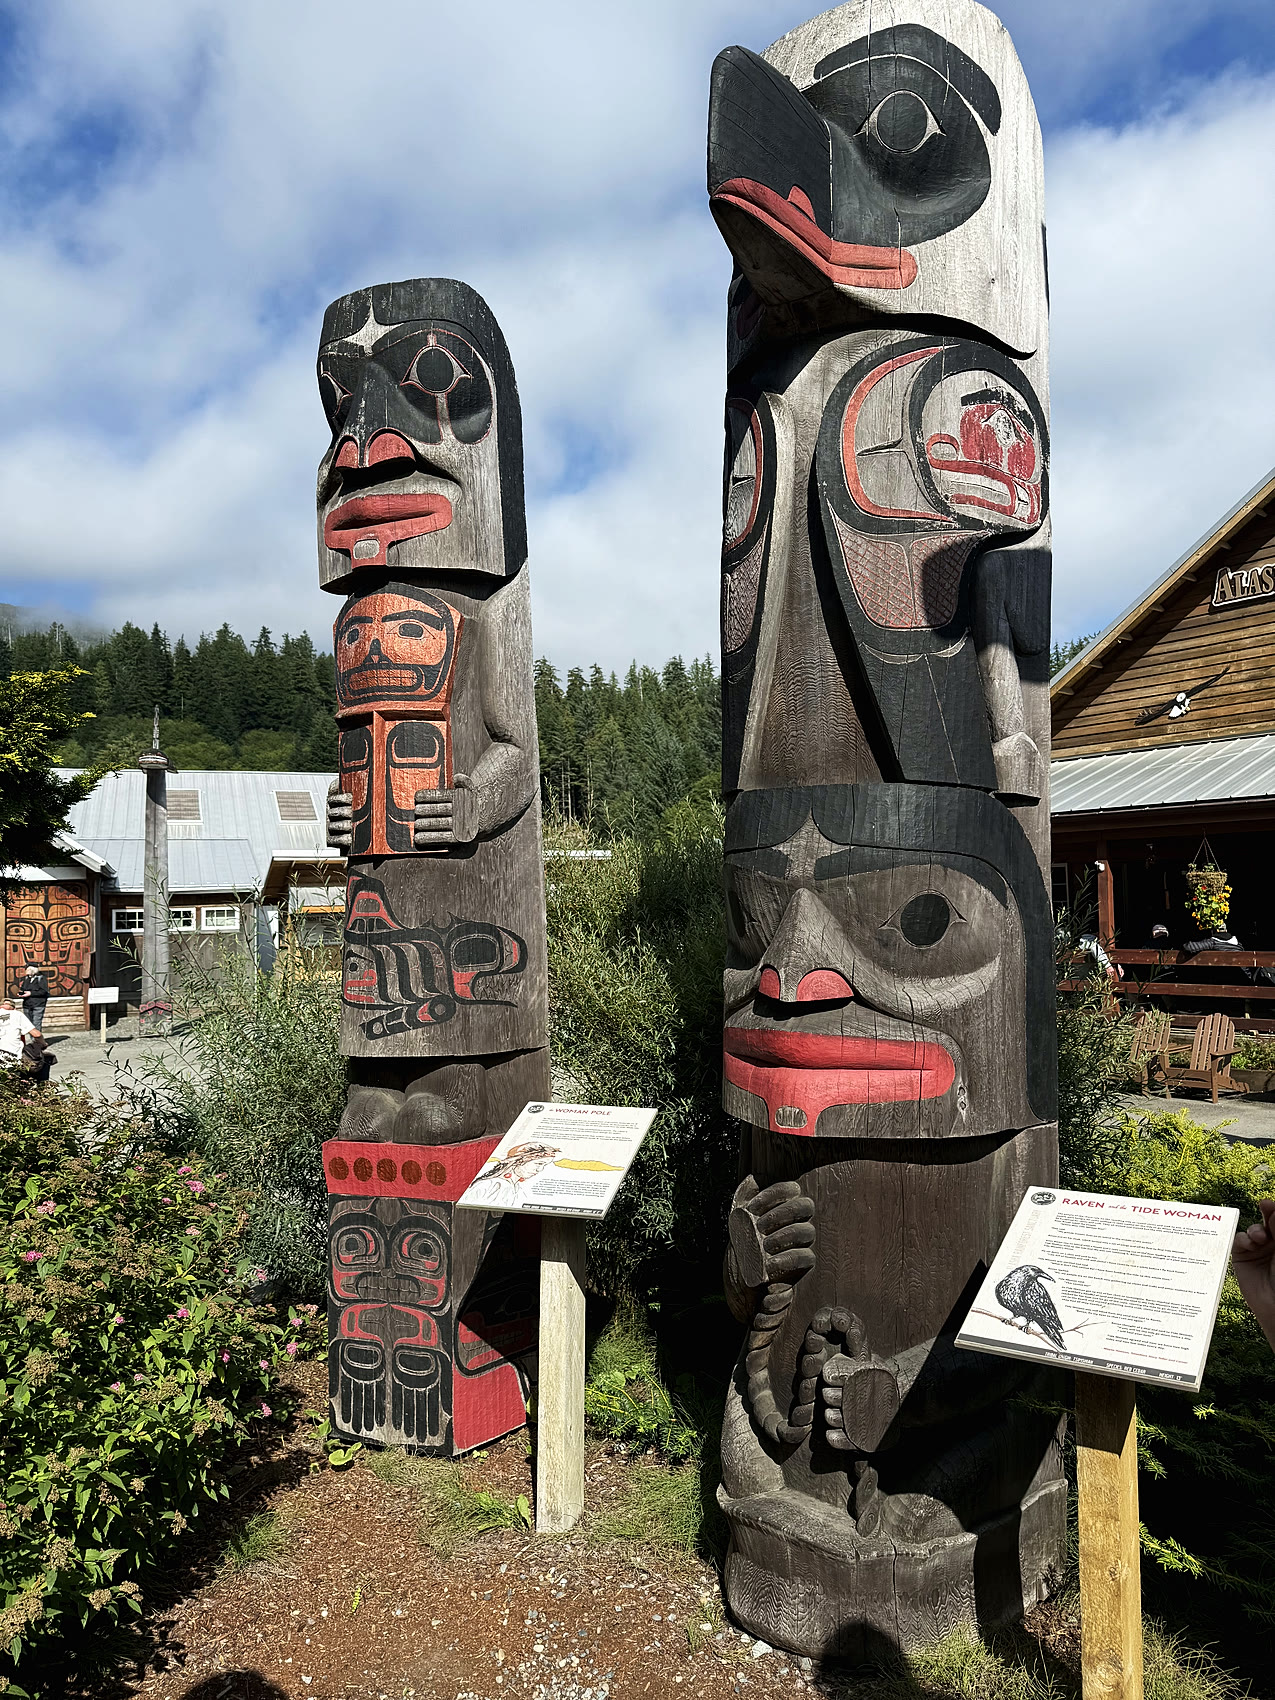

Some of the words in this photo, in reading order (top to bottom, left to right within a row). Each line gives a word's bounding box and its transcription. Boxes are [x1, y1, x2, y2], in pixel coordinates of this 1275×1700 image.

[1215, 566, 1275, 603] ALAS
[1062, 1198, 1105, 1209] RAVEN
[1131, 1205, 1160, 1215] TIDE
[1163, 1209, 1222, 1222] WOMAN
